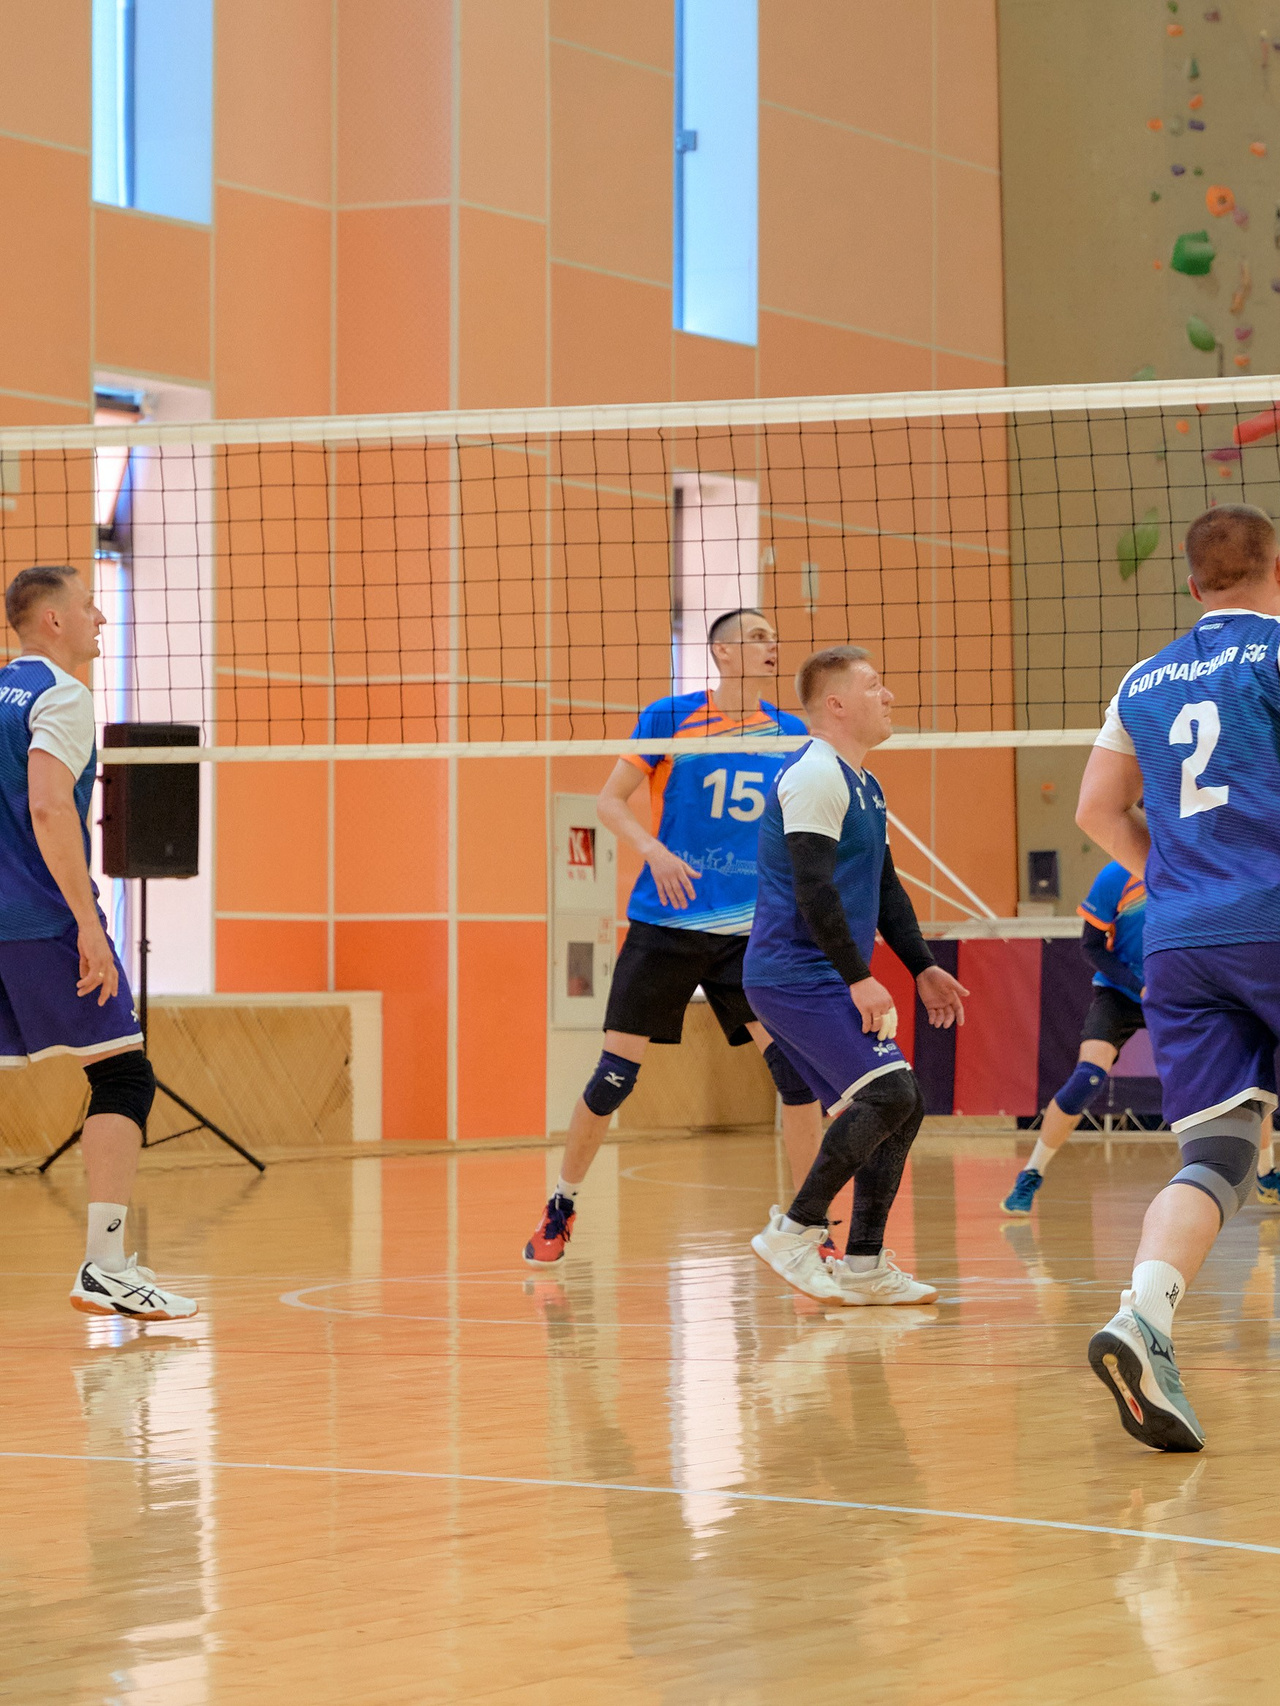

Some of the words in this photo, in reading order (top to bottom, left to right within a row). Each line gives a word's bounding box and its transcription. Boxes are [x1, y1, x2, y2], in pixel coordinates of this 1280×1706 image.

[1128, 645, 1240, 699] БОГУЧАНСКАЯ
[1168, 700, 1230, 819] 2
[702, 768, 766, 822] 15
